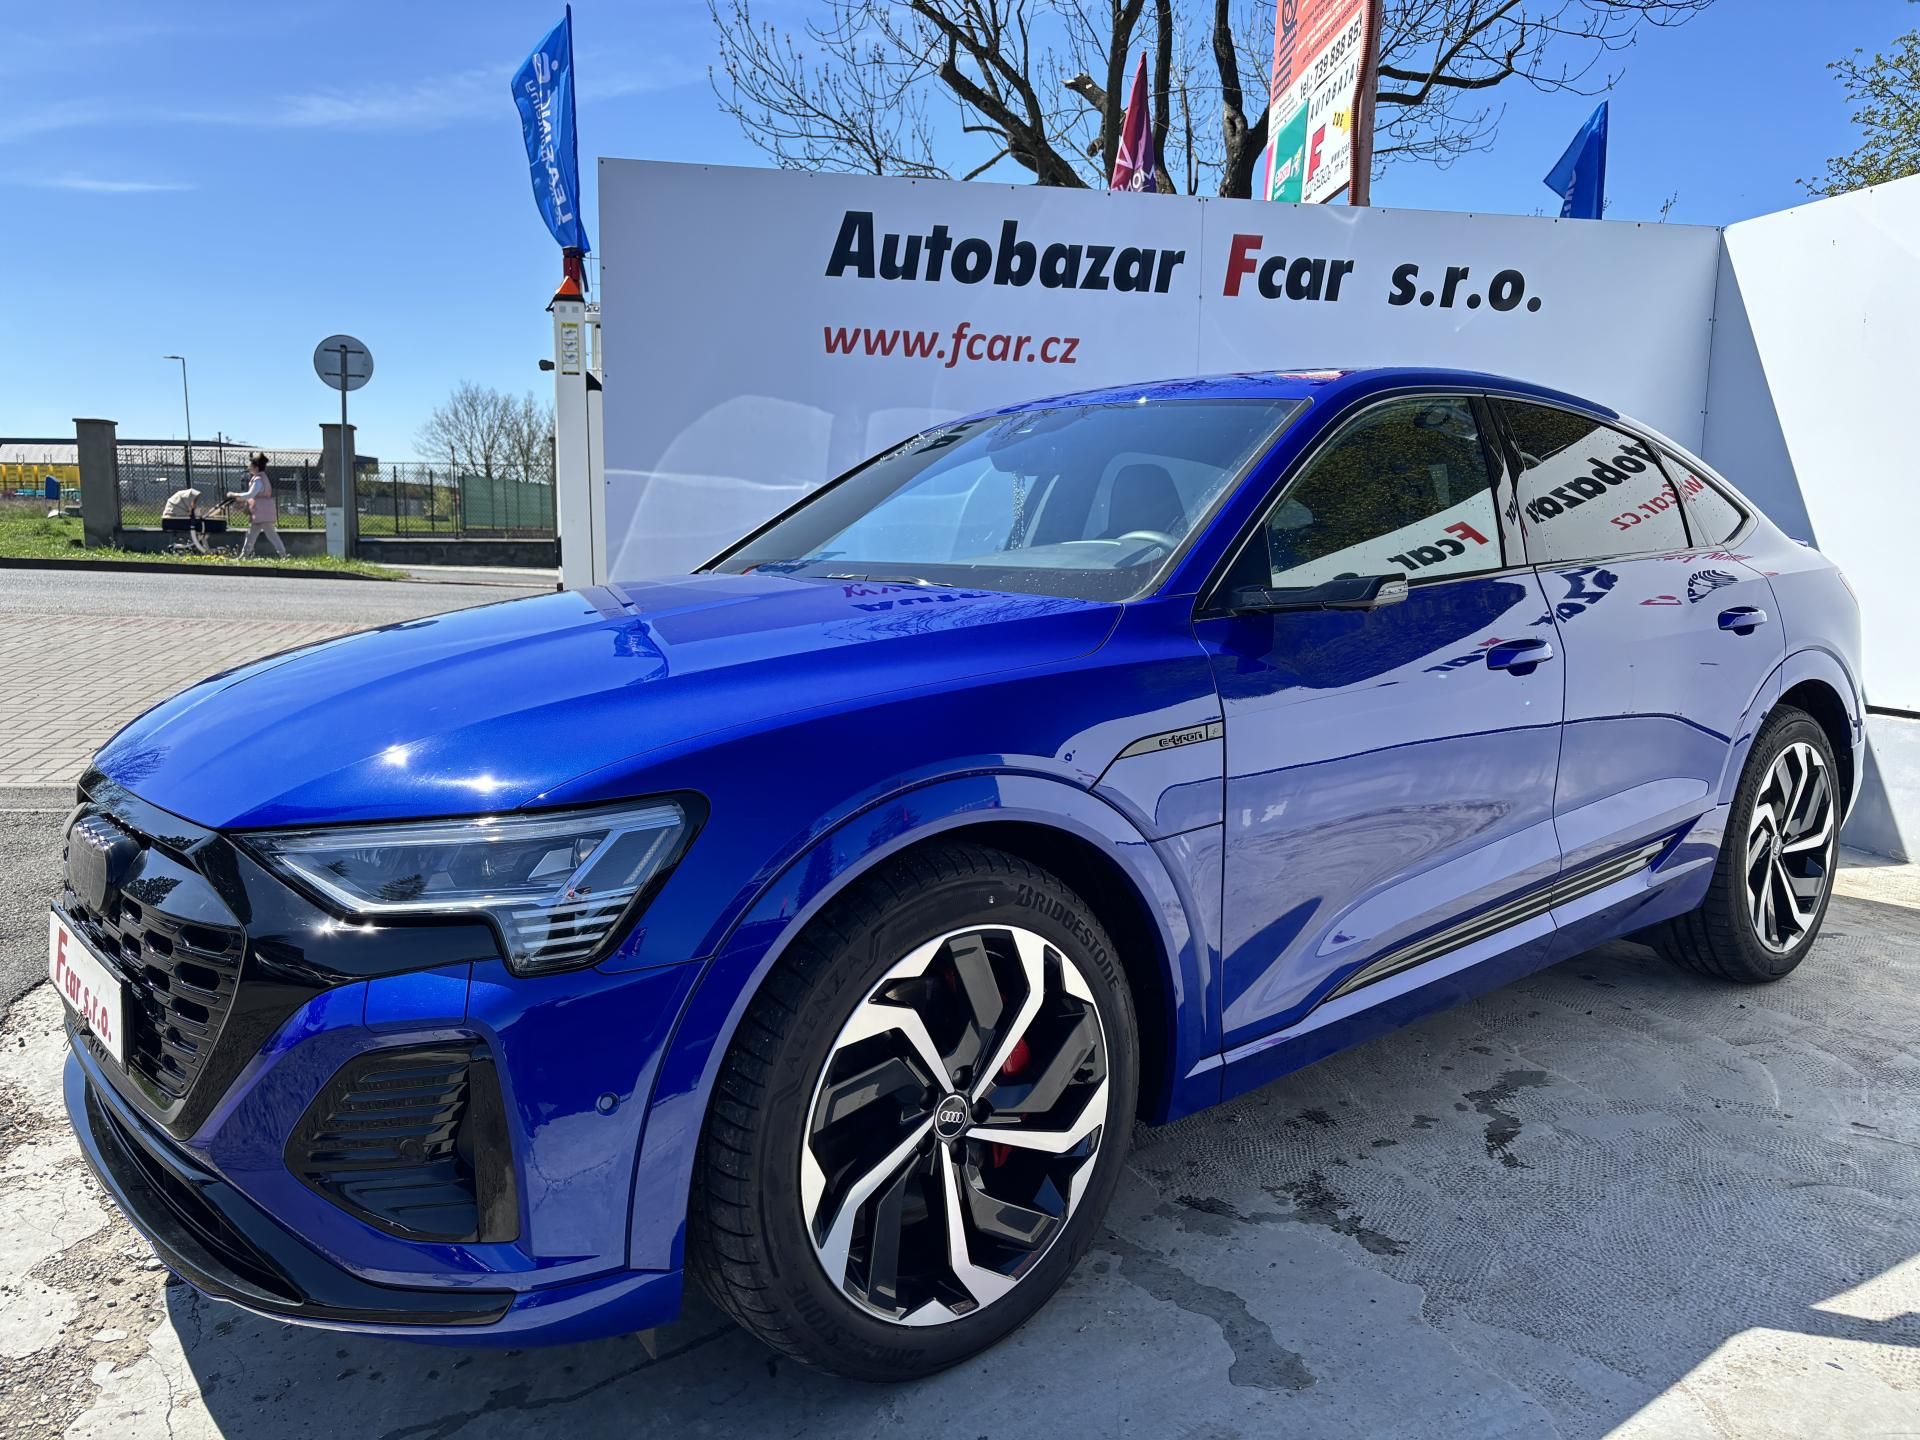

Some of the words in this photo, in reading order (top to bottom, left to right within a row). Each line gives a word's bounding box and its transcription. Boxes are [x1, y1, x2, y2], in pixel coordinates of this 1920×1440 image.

[1314, 54, 1328, 84] 739
[825, 210, 1186, 294] Autobazar
[1223, 233, 1354, 302] Fcar
[1389, 262, 1542, 313] s.r.o.
[823, 322, 1081, 369] www.fcar.cz
[1015, 883, 1120, 993] BRIDGESTONE
